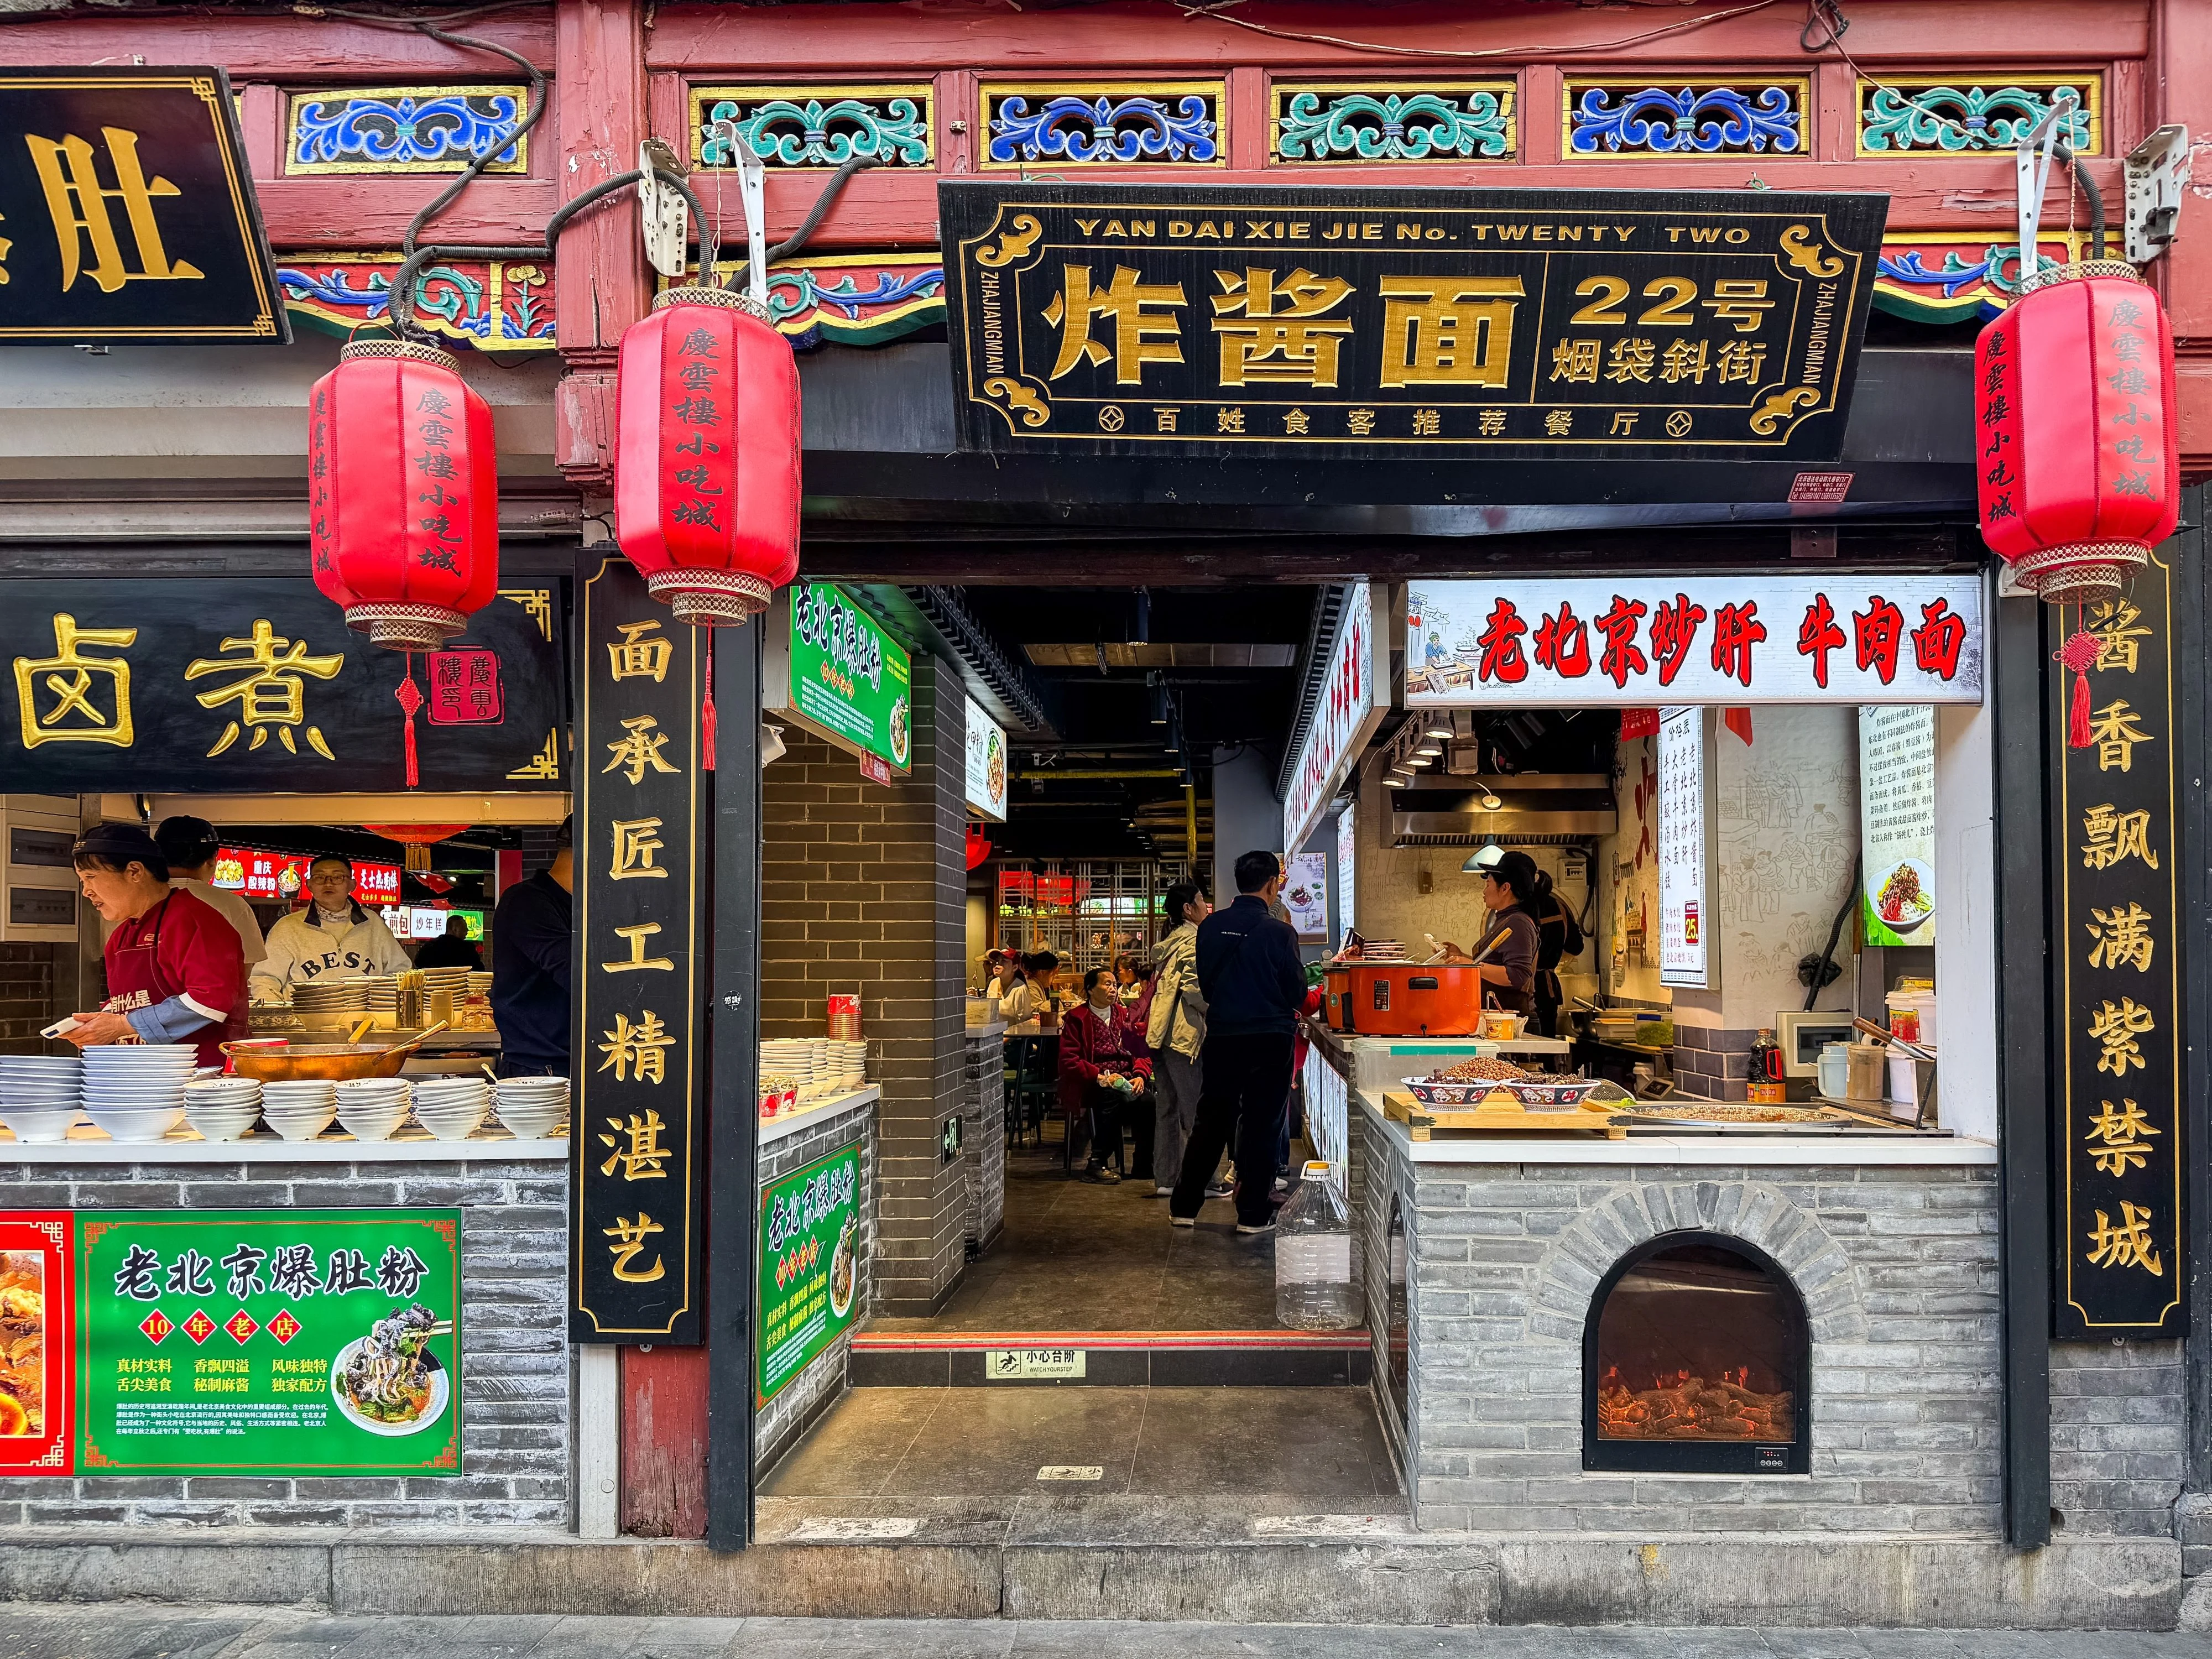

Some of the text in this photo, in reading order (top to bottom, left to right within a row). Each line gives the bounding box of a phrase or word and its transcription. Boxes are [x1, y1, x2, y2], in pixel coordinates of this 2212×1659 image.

[0, 127, 205, 293] 肚
[1074, 218, 1751, 244] YAN DAI XIE JIE No. TWENTY TWO
[980, 271, 1004, 374] ZHAJIANGMIAN
[1041, 263, 1527, 389] 炸酱面
[1569, 276, 1776, 332] 22号
[1807, 282, 1838, 384] ZHAJIANGMIAN
[1549, 337, 1767, 385] 烟袋斜街
[2107, 299, 2157, 502] 慶雲樓小吃城
[671, 327, 723, 533] 慶雲樓小吃城
[1152, 406, 1640, 436] 百姓食客推荐餐厅
[1982, 331, 2017, 523] 慶雲樓小吃城
[413, 388, 463, 578] 慶雲樓小吃城
[796, 584, 882, 693] 老北京爆肚粉
[1477, 592, 1968, 690] 老北京炒肝 牛肉面
[13, 612, 344, 761] 卤煮
[248, 875, 276, 891] 酸辣粉
[253, 860, 272, 875] 重庆
[300, 952, 375, 979] BEST
[416, 916, 442, 931] 炒年糕
[597, 619, 682, 1283] 面承匠工精湛艺
[2080, 596, 2163, 1277] 酱香飘满紫禁城
[768, 1159, 855, 1253] 老北京爆肚粉
[114, 1243, 430, 1302] 老北京爆肚粉
[116, 1358, 328, 1374] 真材实料 香飘四溢 风味独特
[147, 1318, 295, 1338] 10年老店
[1026, 1350, 1076, 1363] 小心台阶
[116, 1377, 327, 1392] 舌尖美食 秘制麻酱 独家配方
